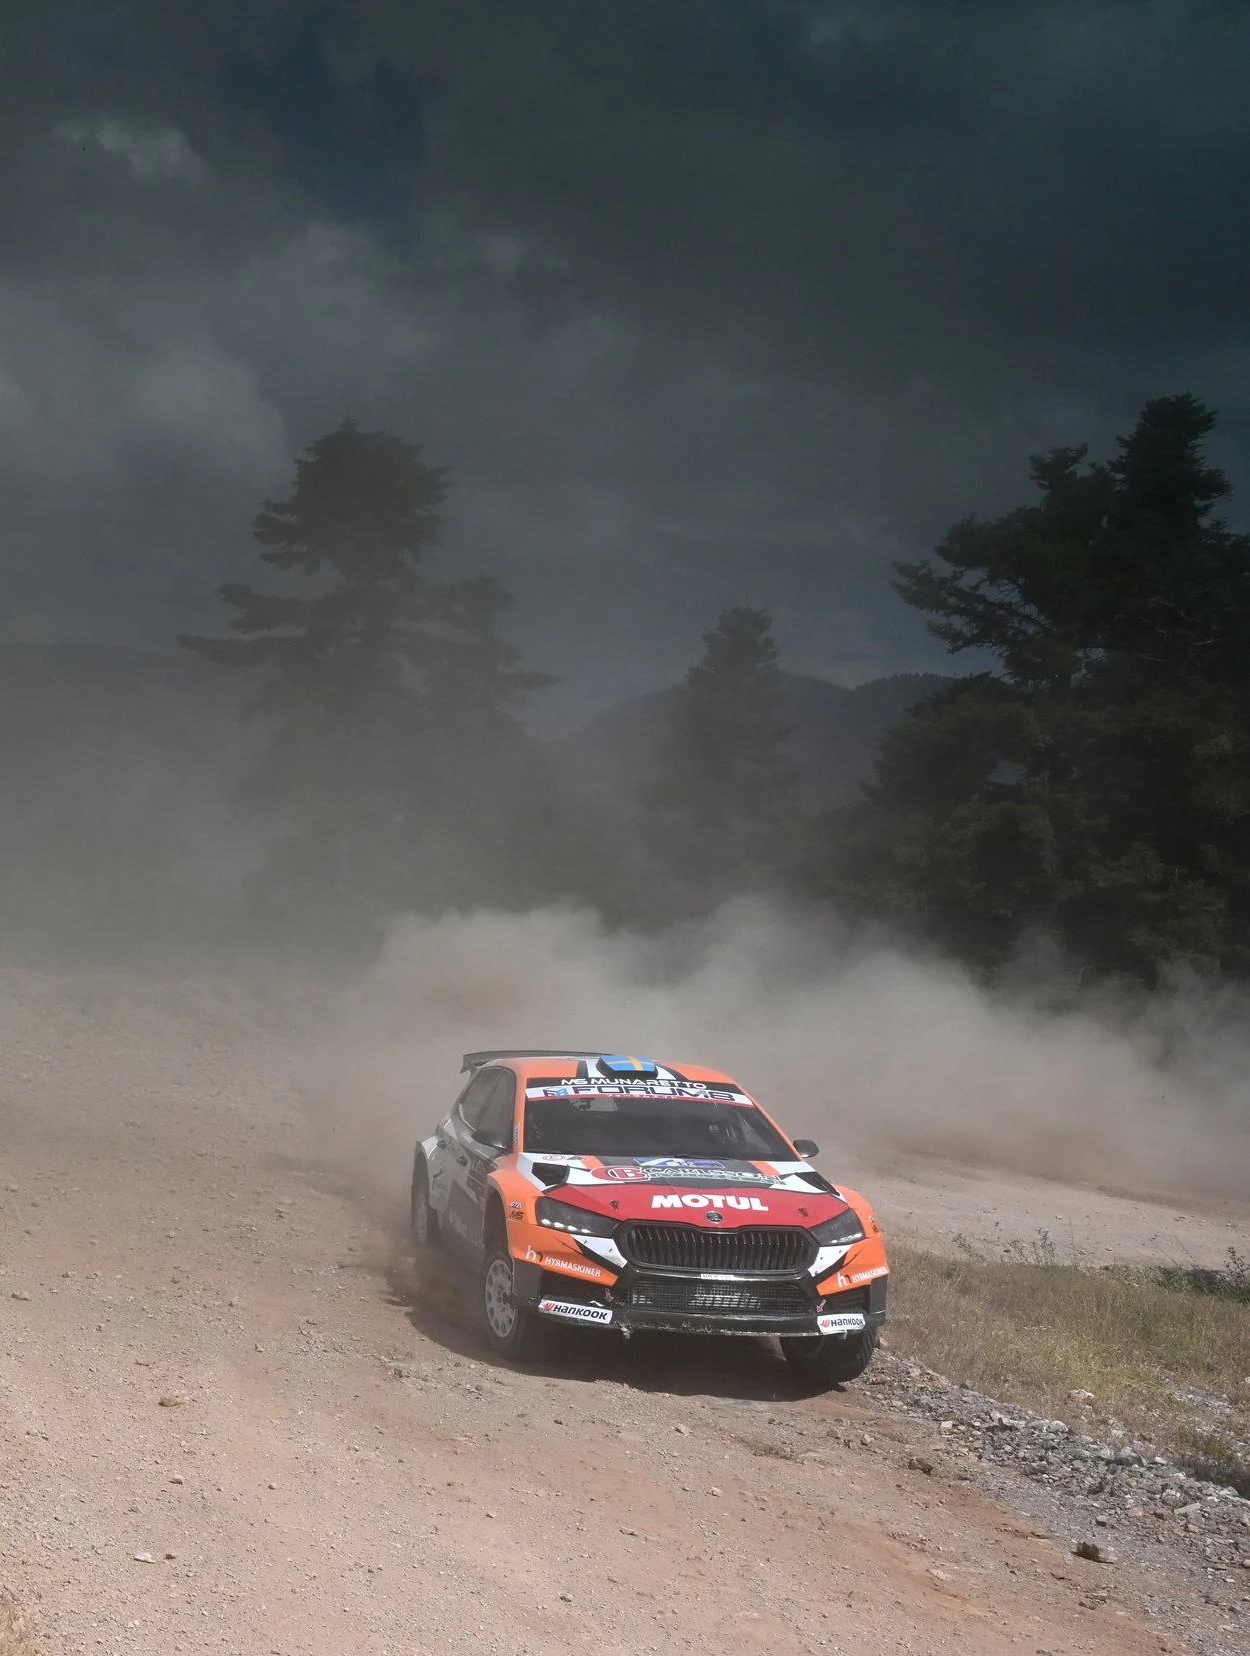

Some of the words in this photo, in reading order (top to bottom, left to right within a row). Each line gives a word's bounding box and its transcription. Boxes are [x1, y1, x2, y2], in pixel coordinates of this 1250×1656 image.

[590, 1078, 707, 1090] MUNARETTO
[573, 1085, 736, 1102] FORUM8
[651, 1194, 769, 1212] MOTUL
[544, 1256, 602, 1278] HYRMASKINER
